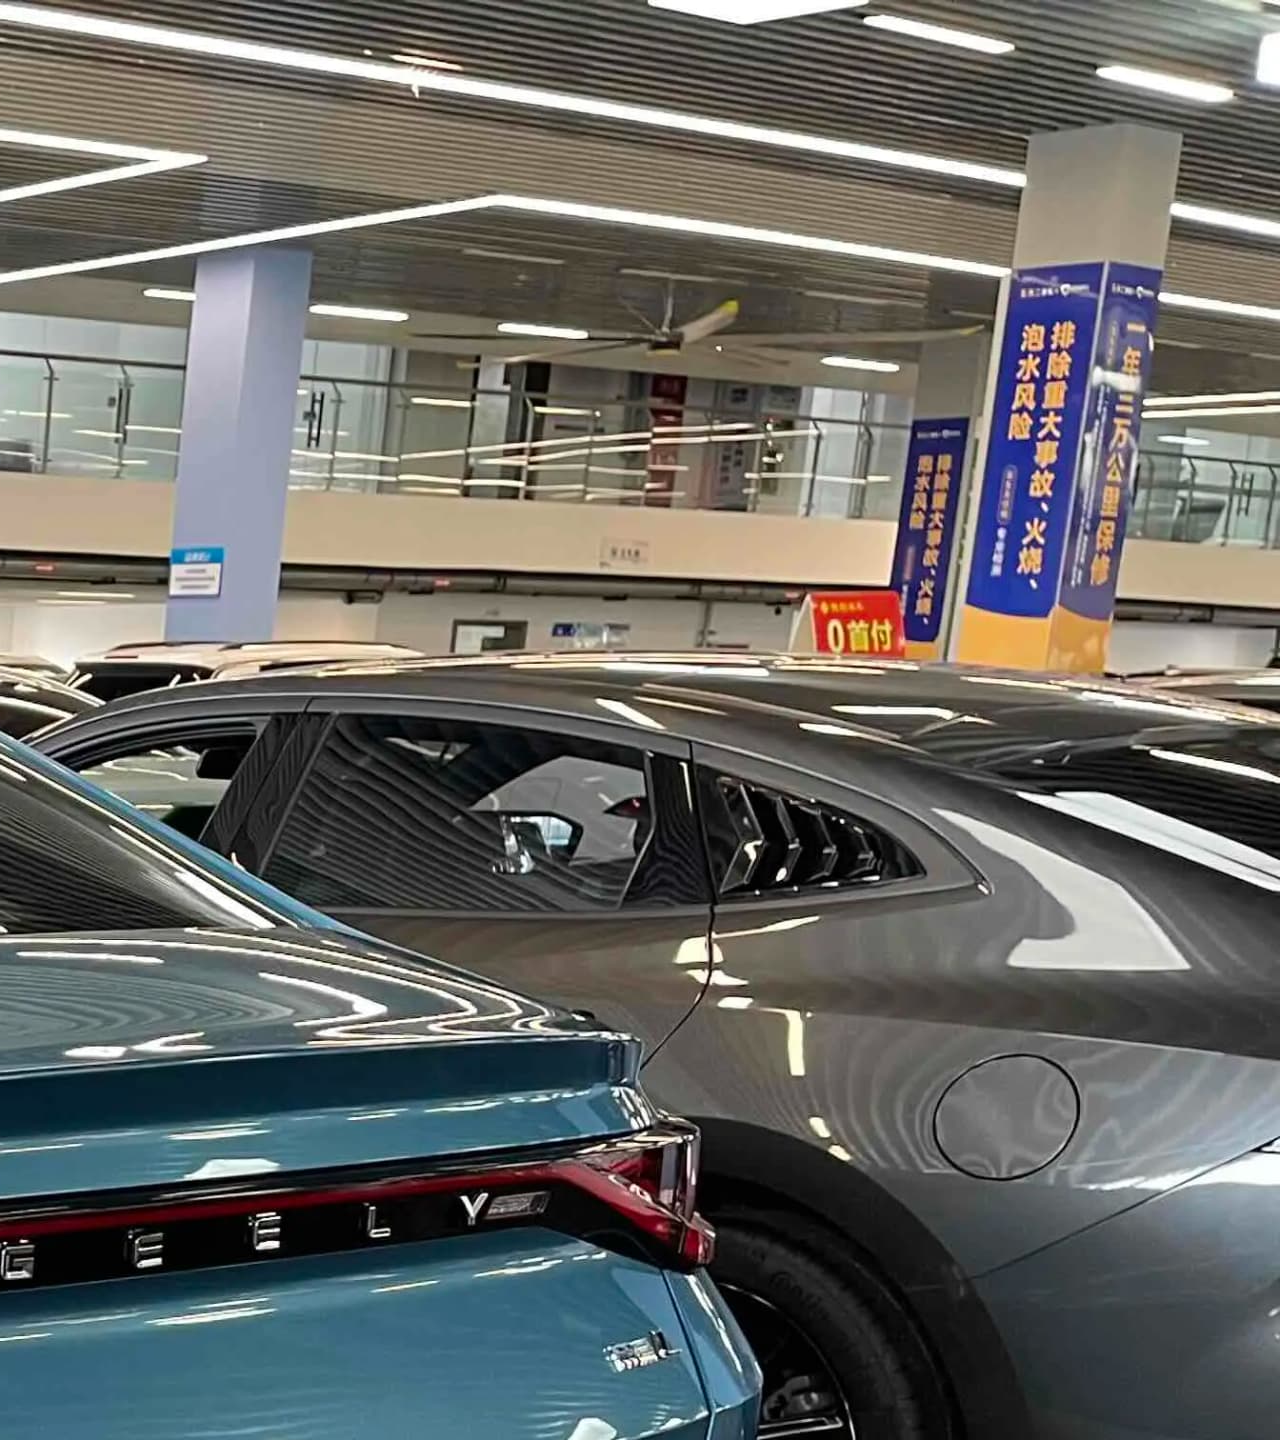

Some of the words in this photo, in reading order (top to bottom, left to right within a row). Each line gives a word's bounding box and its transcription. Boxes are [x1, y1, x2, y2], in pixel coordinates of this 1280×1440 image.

[1006, 323, 1046, 441] 泡水风险
[827, 617, 893, 654] 0首付
